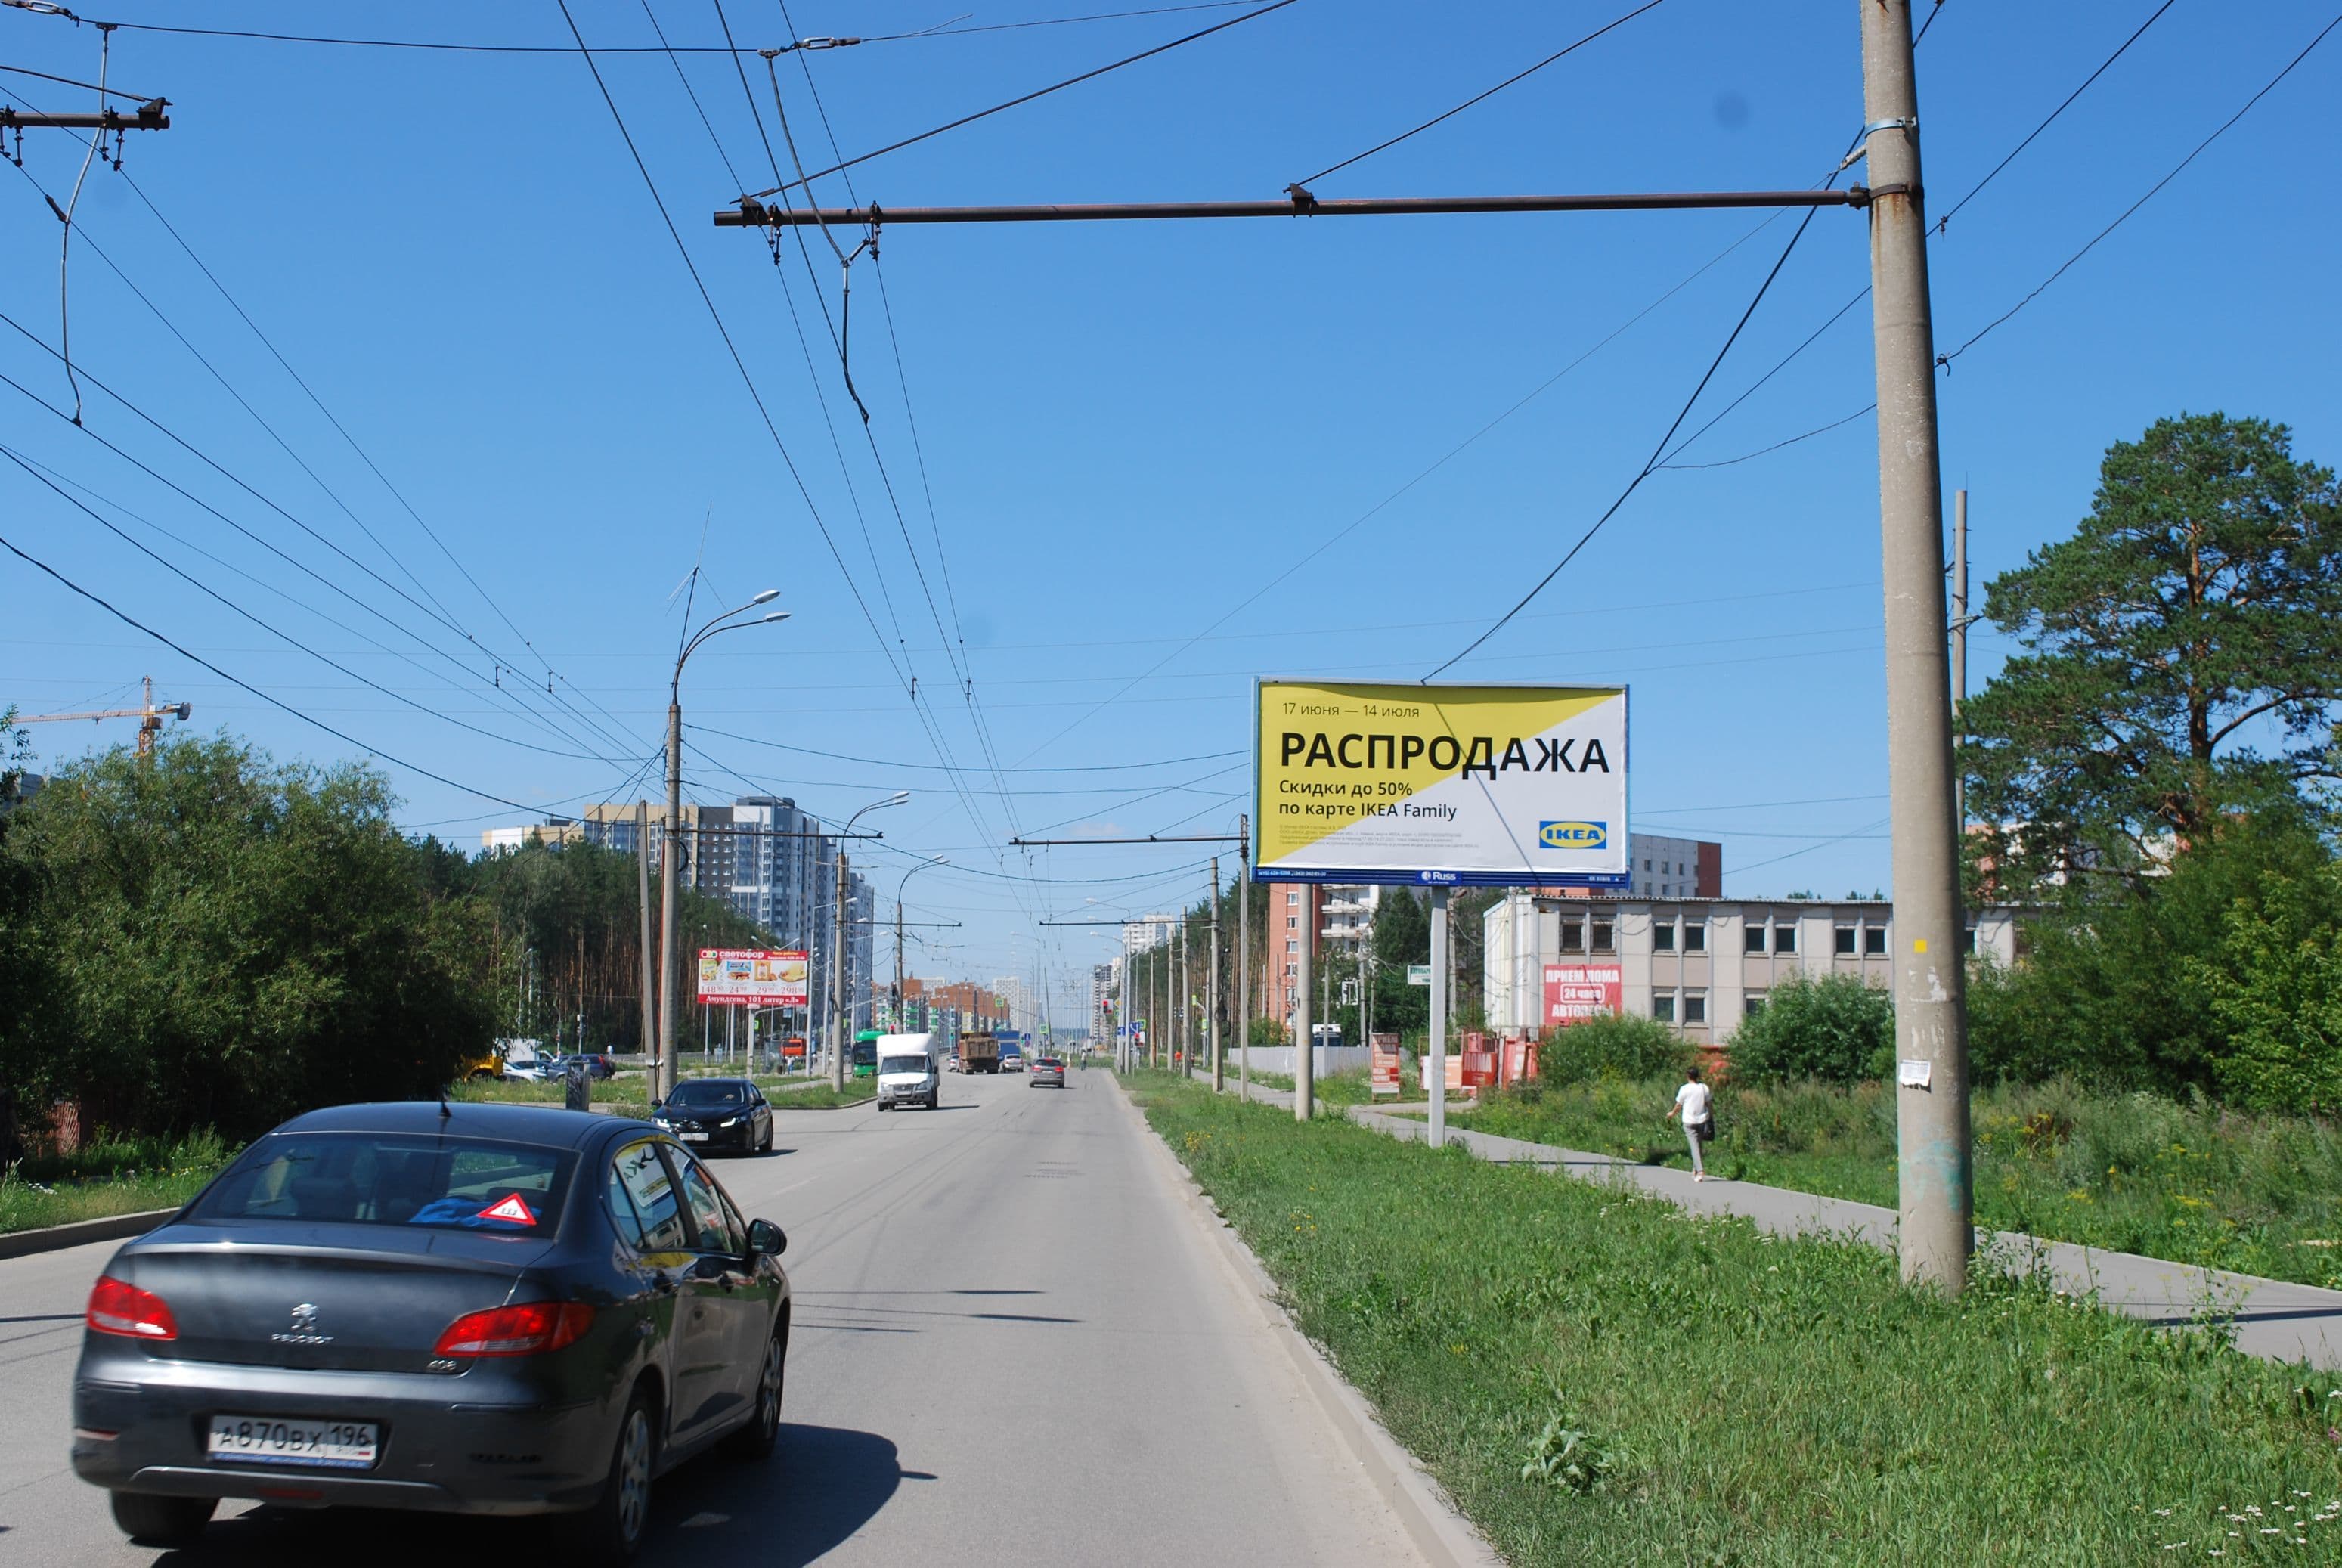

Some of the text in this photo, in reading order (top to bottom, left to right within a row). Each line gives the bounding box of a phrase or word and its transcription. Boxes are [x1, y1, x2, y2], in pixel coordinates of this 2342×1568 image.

[1283, 703, 1296, 715] 17
[1300, 705, 1340, 717] июня
[1363, 705, 1377, 717] 14
[1382, 707, 1420, 718] июля
[1281, 732, 1610, 781] РАСПРОДАЖА
[1279, 780, 1413, 798] Скидки до 50%
[1279, 803, 1458, 822] по карте IKEA Family
[1544, 829, 1601, 841] IKEA
[1433, 872, 1456, 881] Russ
[1545, 969, 1619, 982] ПРИЕМ ЛОМА
[1563, 987, 1576, 999] 24
[271, 1334, 334, 1344] PEUGEOT
[220, 1421, 370, 1453] А870ВХ 196
